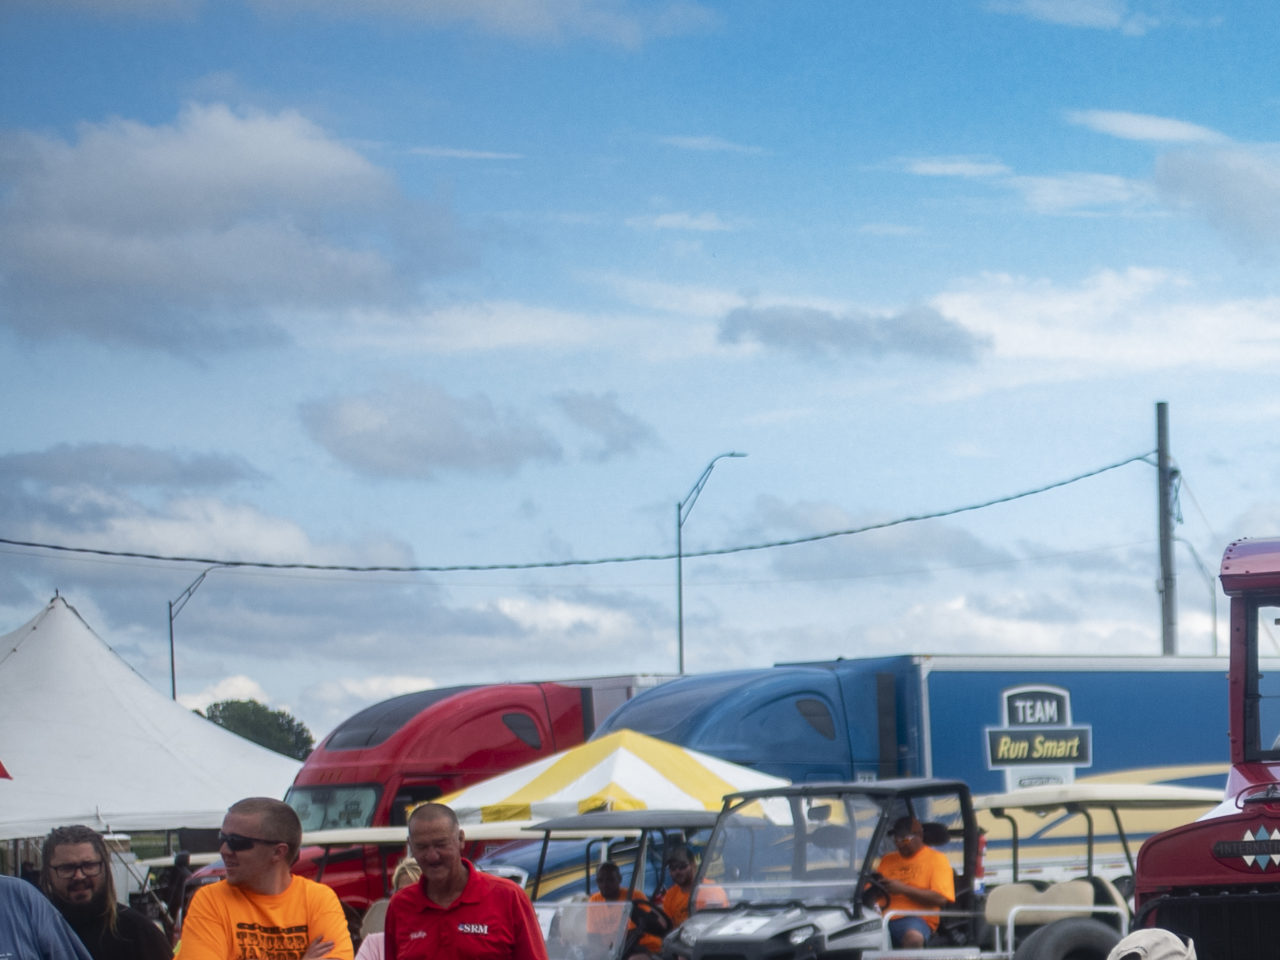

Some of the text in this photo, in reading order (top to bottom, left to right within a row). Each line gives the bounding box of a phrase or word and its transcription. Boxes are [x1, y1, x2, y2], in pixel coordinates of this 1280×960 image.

[1016, 700, 1058, 722] TEAM
[998, 736, 1080, 759] Run Smart
[463, 923, 489, 934] SRM
